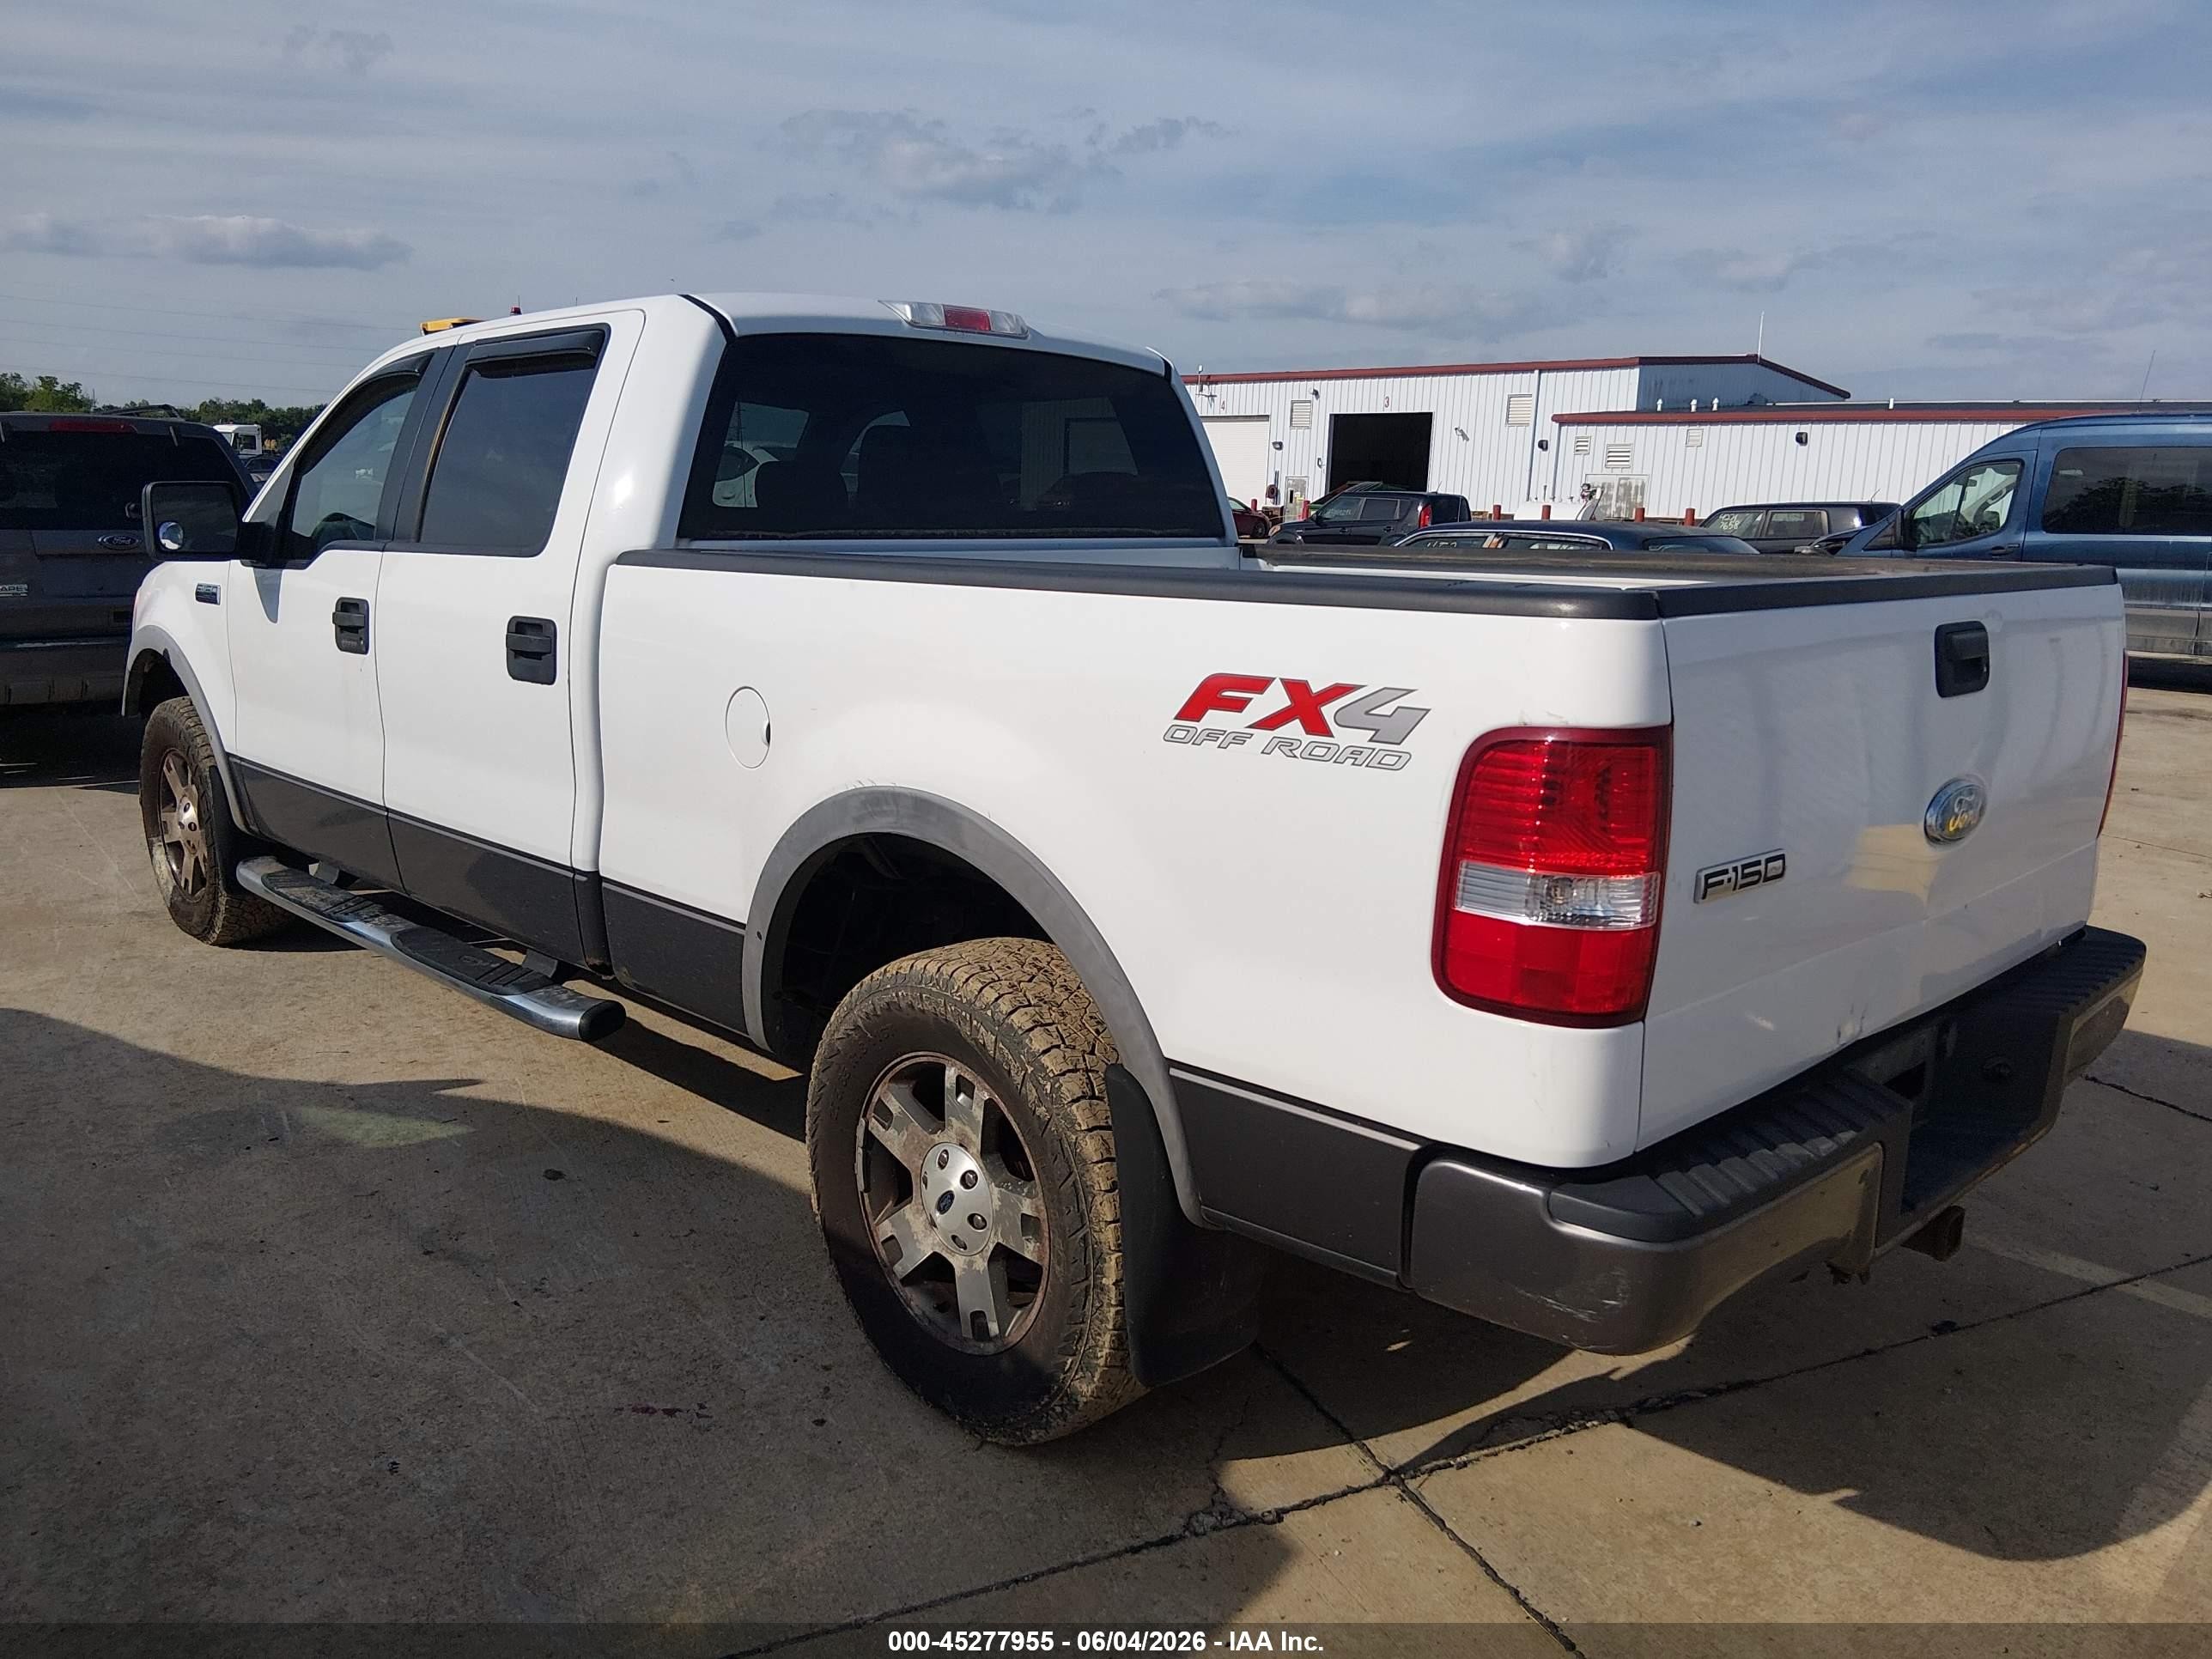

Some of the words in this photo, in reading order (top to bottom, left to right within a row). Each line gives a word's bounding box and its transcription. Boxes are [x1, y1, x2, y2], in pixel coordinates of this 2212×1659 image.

[1220, 400, 1225, 410] 4
[1384, 396, 1389, 408] 3
[1173, 672, 1431, 745] FX4
[1163, 724, 1253, 749] OFF
[1261, 737, 1413, 771] ROAD
[1947, 794, 1982, 832] Ford
